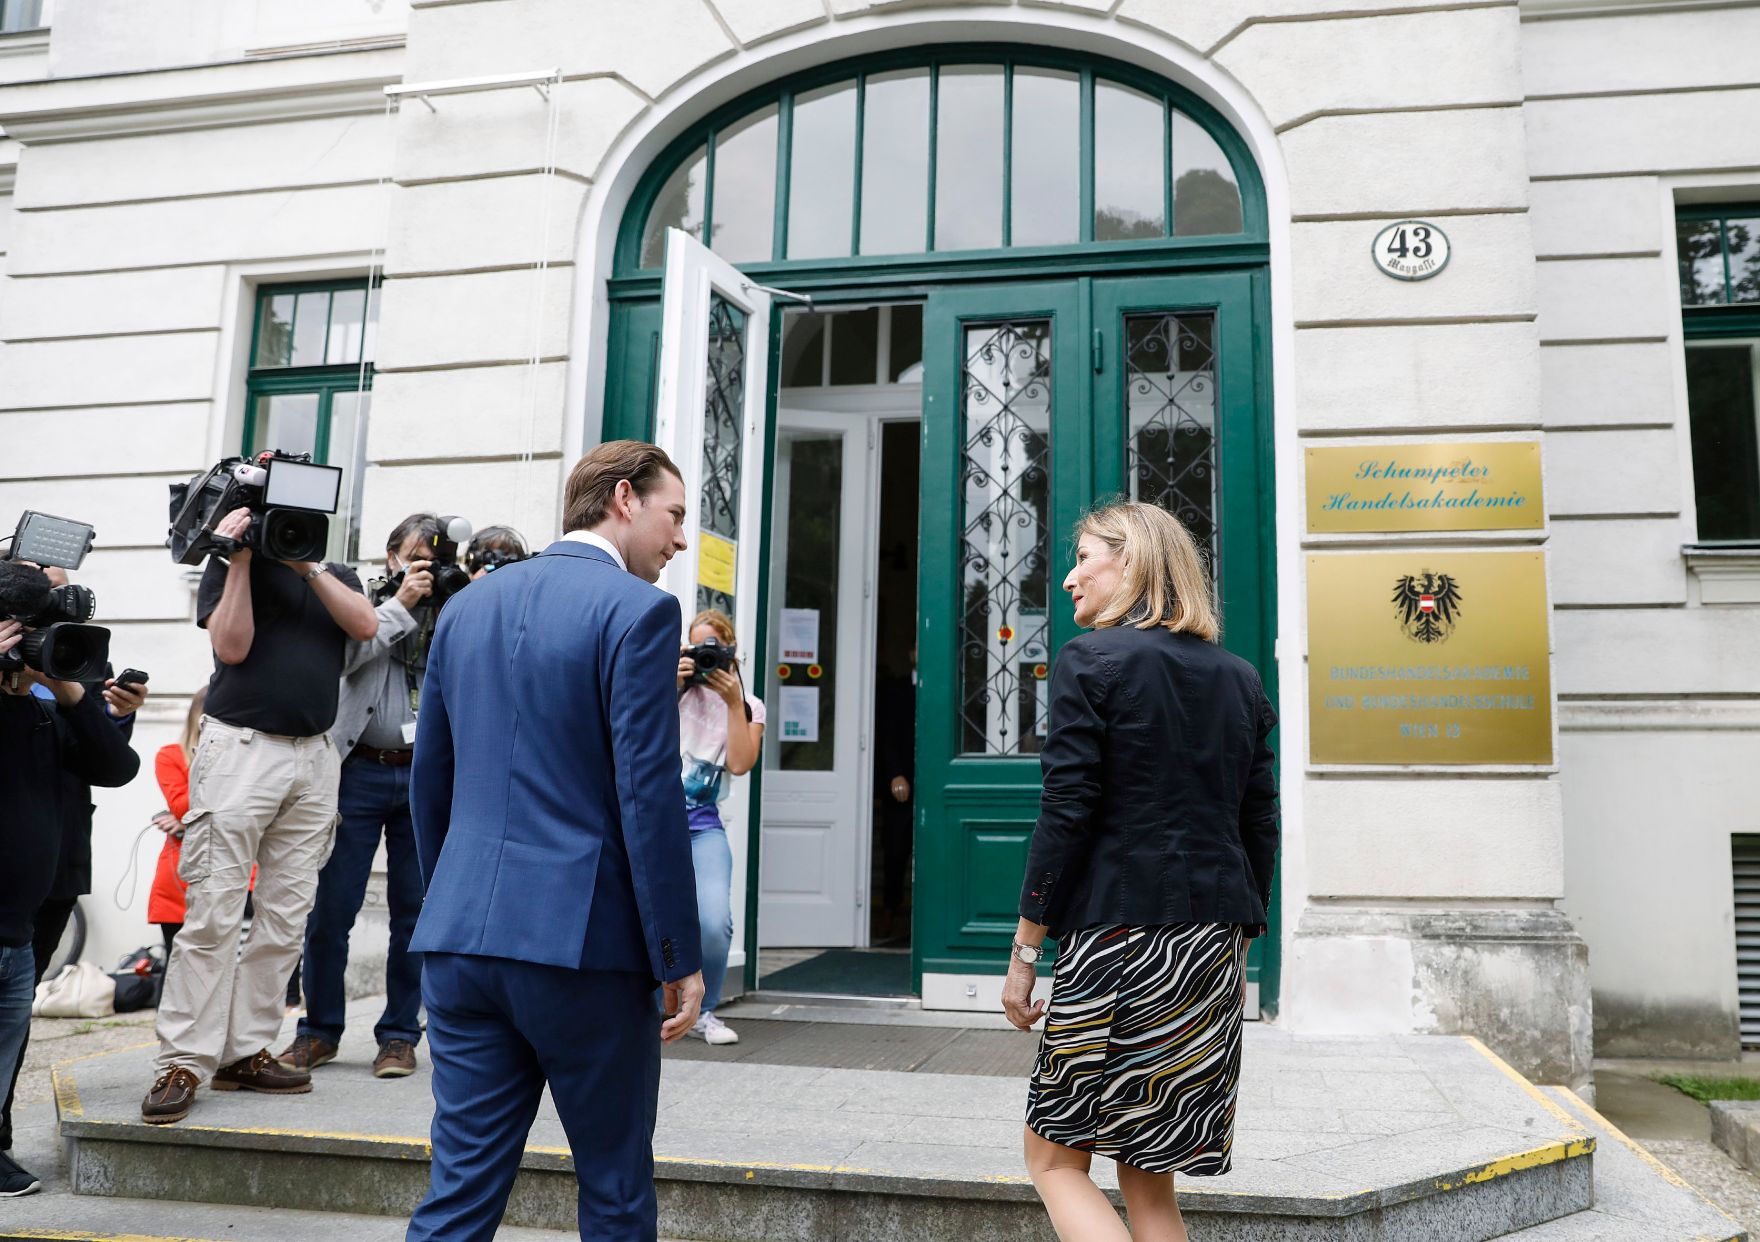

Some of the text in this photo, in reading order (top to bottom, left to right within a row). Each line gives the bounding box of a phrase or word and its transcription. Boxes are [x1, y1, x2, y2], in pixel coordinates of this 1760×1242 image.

[1387, 227, 1432, 258] 43
[1355, 457, 1490, 484] Schumpeter
[1322, 489, 1527, 511] Handelsakademie
[1325, 694, 1353, 709] UND
[1400, 723, 1438, 738] WIEN
